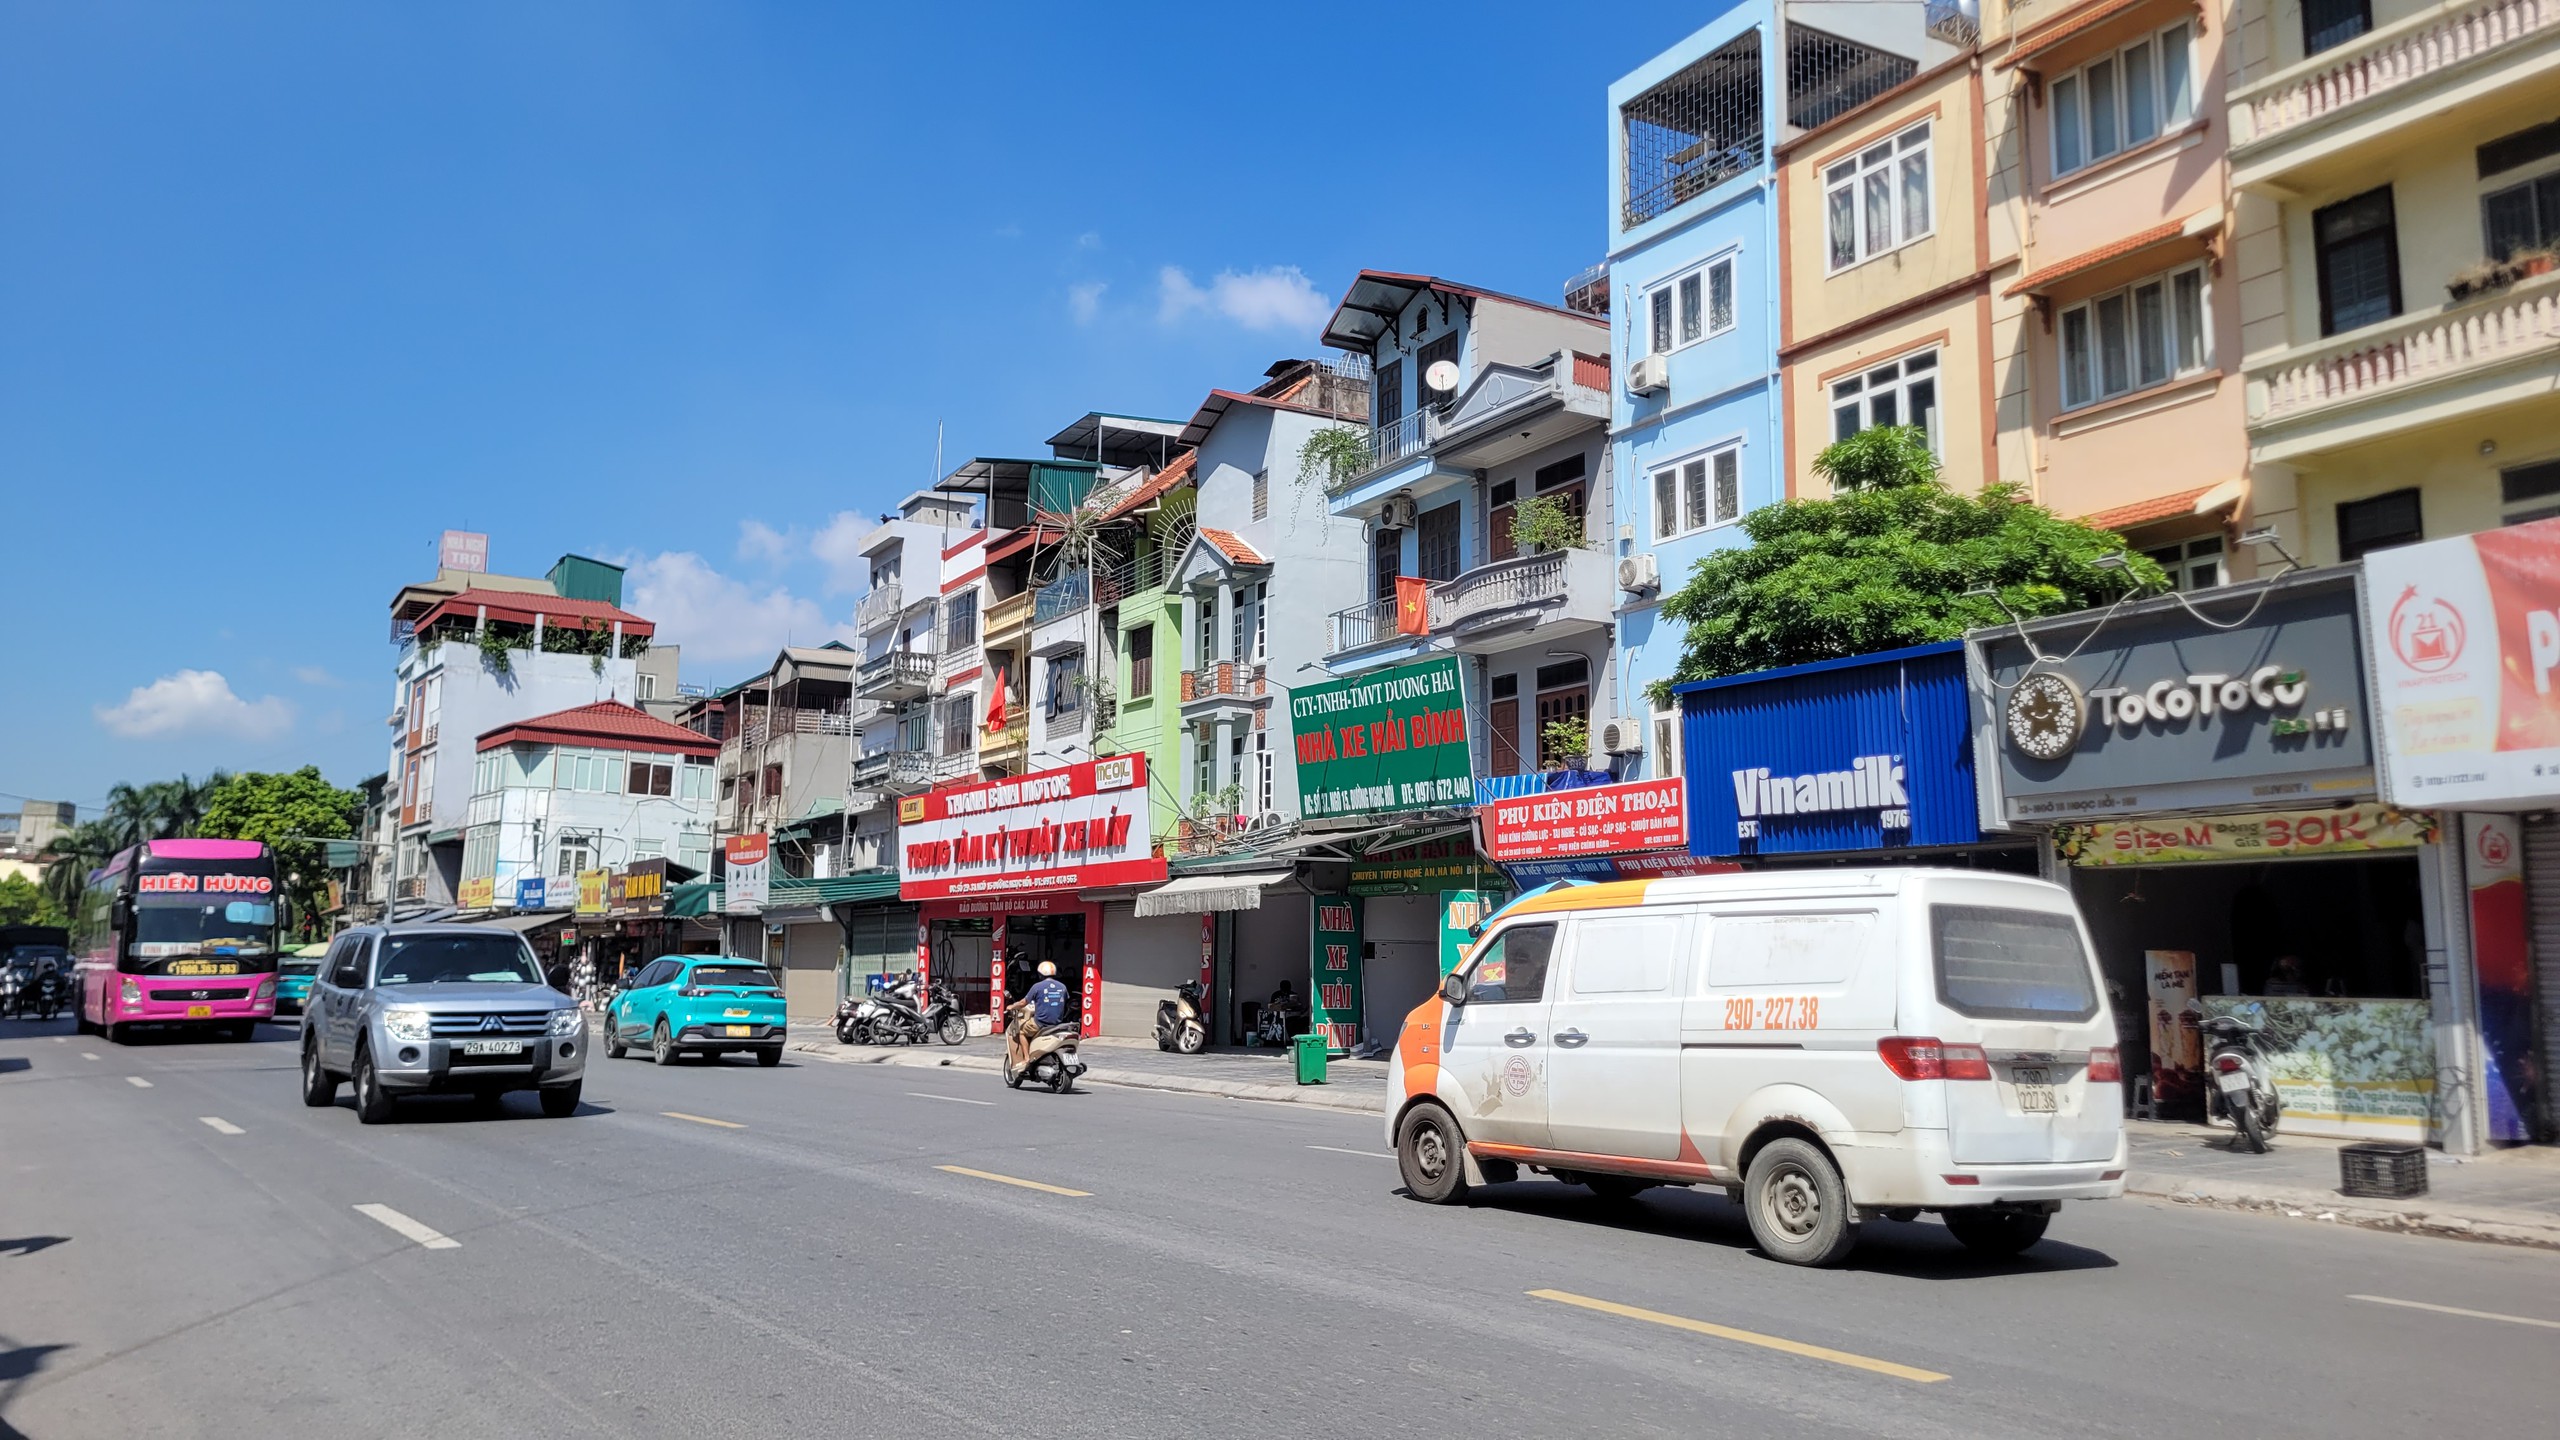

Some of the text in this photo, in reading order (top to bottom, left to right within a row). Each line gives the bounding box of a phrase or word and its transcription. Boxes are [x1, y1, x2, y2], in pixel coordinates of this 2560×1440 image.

[1430, 664, 1455, 694] HẢI
[1296, 706, 1465, 764] NHÀ XE HẢI BÌNH
[946, 774, 1071, 816] THANH BÌNH MOTOR
[1416, 780, 1436, 804] 0976
[1454, 776, 1471, 799] 449
[1732, 755, 1909, 817] Vinamilk
[1498, 787, 1678, 827] PHỤ KIỆN ĐIỆN THOẠI
[1880, 809, 1909, 829] 1976
[907, 839, 951, 868] TRUNG
[953, 828, 984, 864] TÂM
[1009, 817, 1062, 861] THUẬT
[1064, 821, 1087, 851] XE
[1088, 805, 1132, 848] MÁY
[2114, 811, 2368, 850] Size M 30K
[1618, 859, 1641, 872] PHỤ
[1641, 856, 1668, 871] KIỆN
[1319, 901, 1355, 932] NHÀ
[1325, 944, 1349, 970] XE
[991, 949, 1002, 1022] HONDA
[1321, 977, 1352, 1010] HẢI
[1725, 997, 1754, 1030] 29D
[1765, 996, 1818, 1030] 227.38
